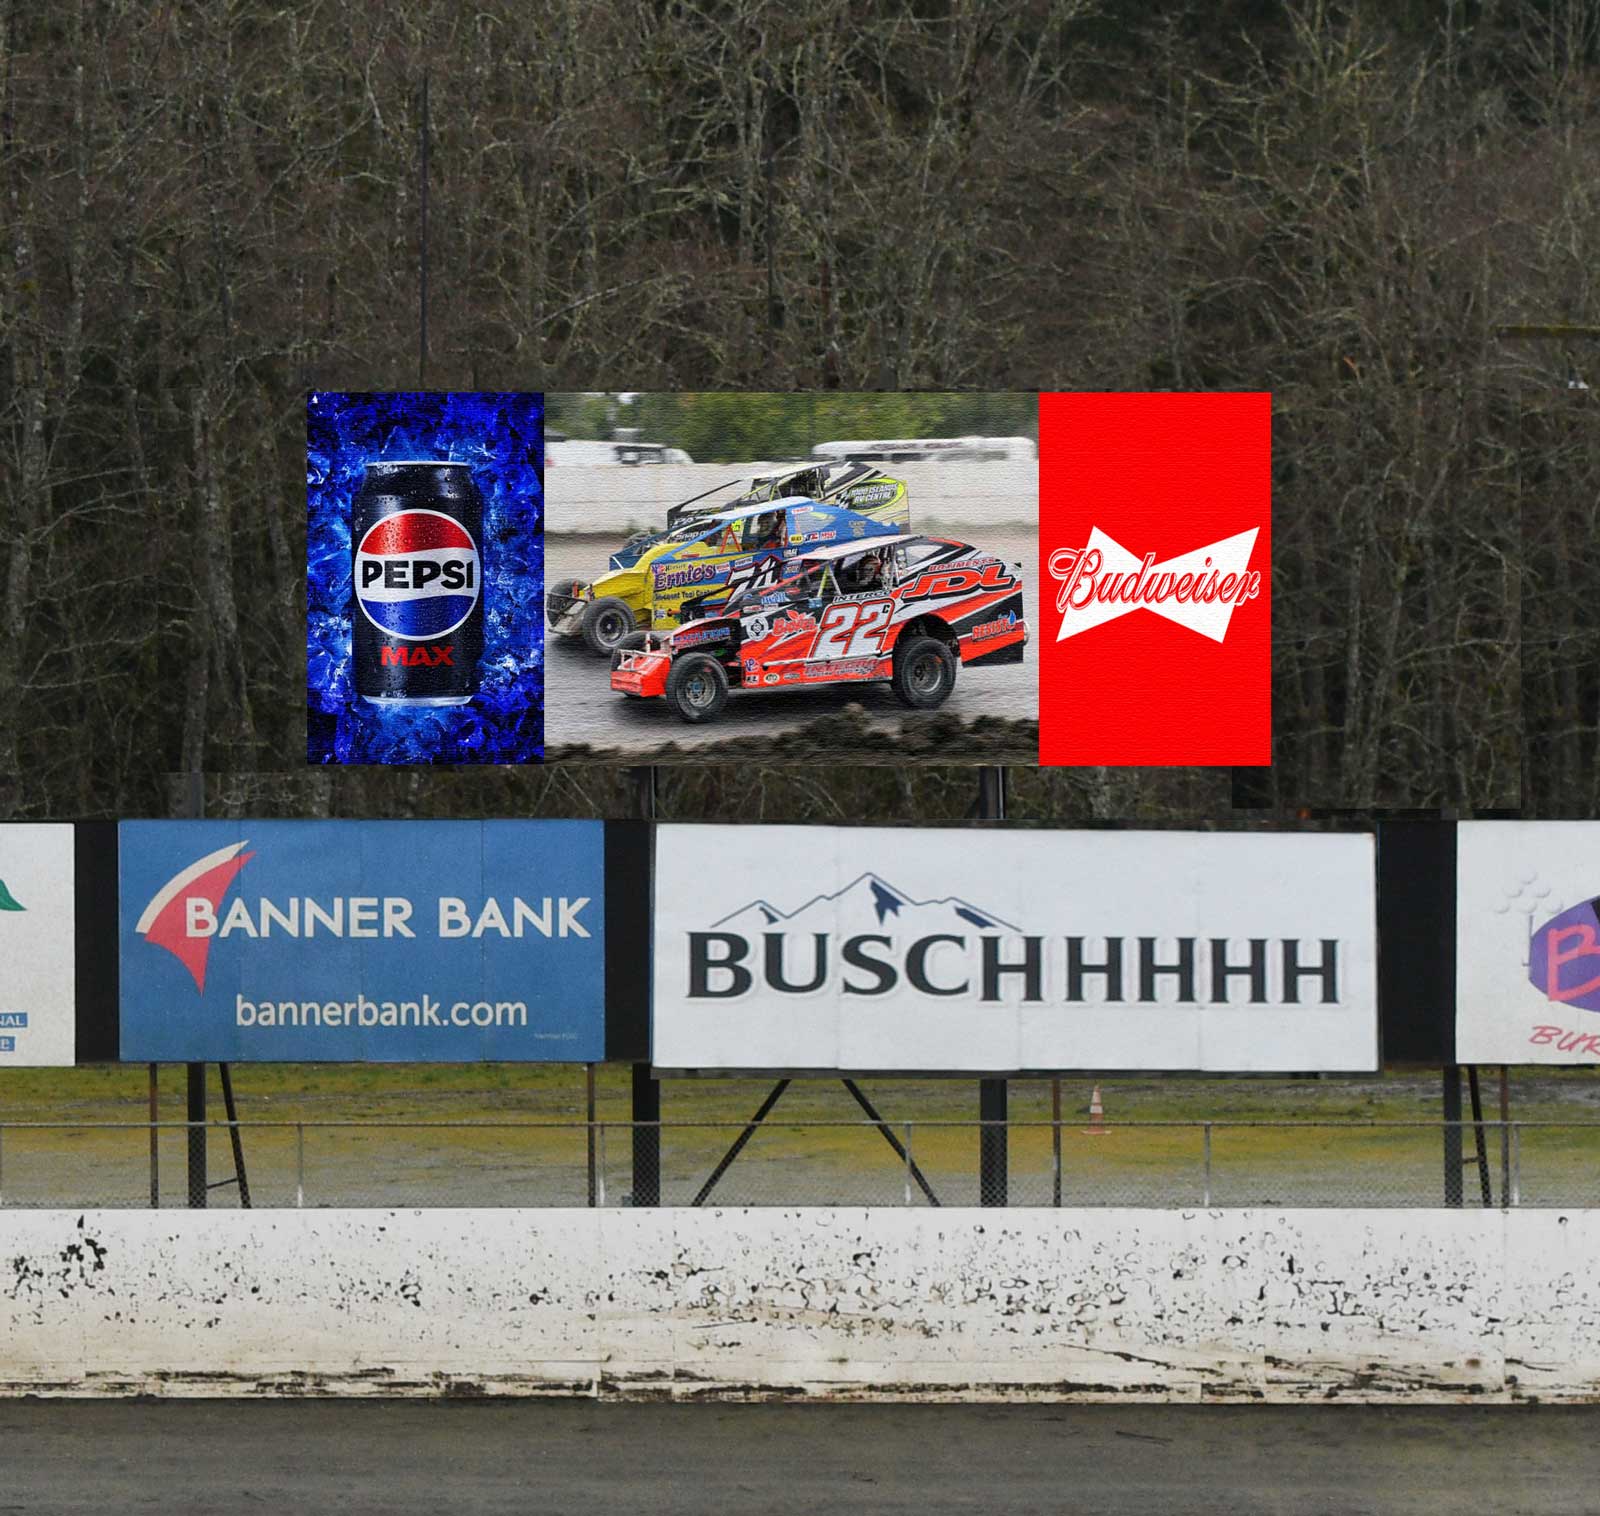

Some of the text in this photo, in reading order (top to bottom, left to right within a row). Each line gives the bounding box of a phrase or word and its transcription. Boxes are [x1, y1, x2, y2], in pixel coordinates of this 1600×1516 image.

[362, 560, 474, 589] PEPSI
[653, 563, 717, 592] Ernie's
[903, 562, 1016, 599] JDL
[1048, 547, 1261, 613] Budweiser
[810, 600, 893, 660] 22
[381, 645, 455, 667] MAX
[185, 897, 592, 939] BANNER BANK
[236, 994, 528, 1027] bannerbank.com
